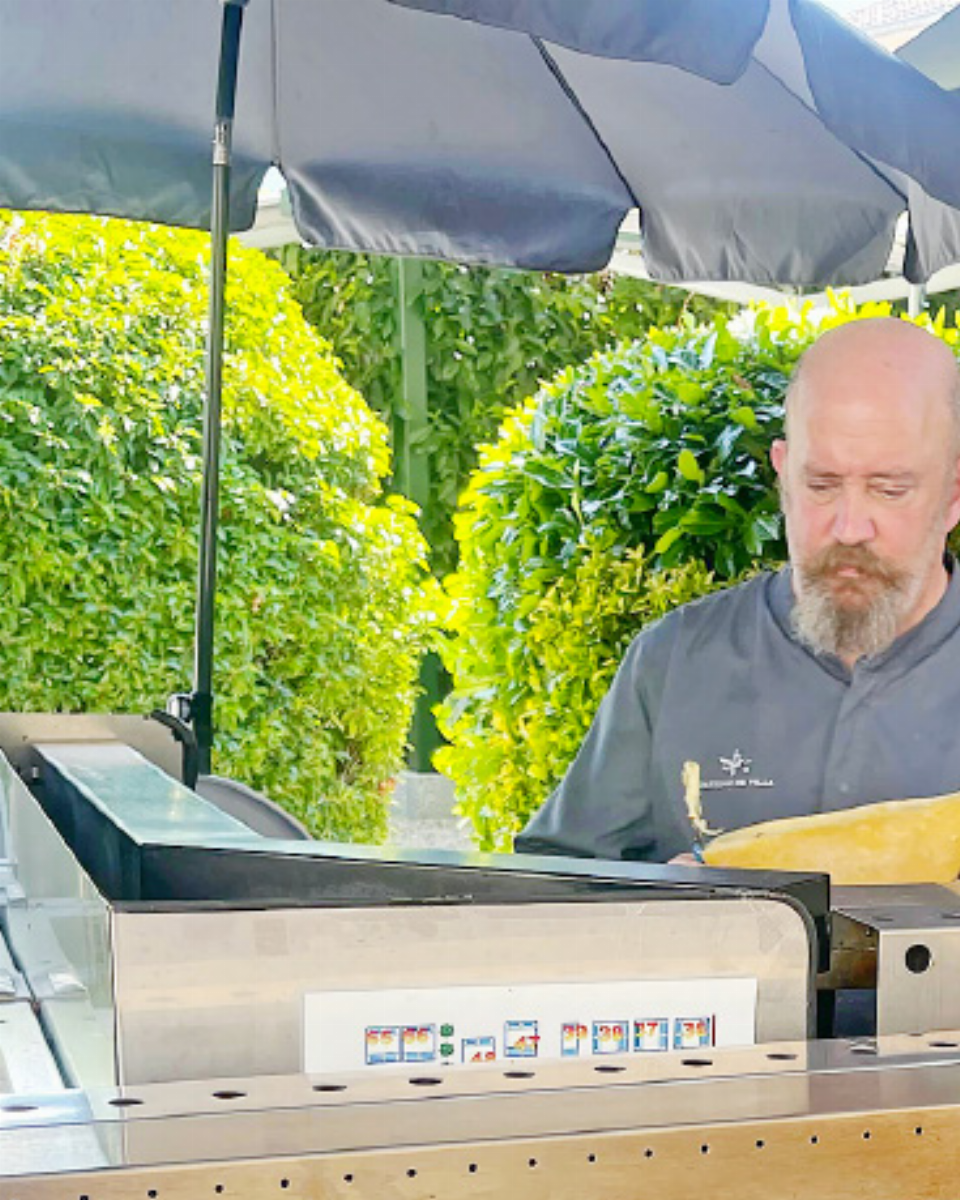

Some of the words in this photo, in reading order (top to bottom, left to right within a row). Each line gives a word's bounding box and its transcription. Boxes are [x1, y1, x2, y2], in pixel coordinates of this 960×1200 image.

[599, 1025, 624, 1042] 38
[634, 1021, 659, 1038] 37
[514, 1035, 541, 1051] 47
